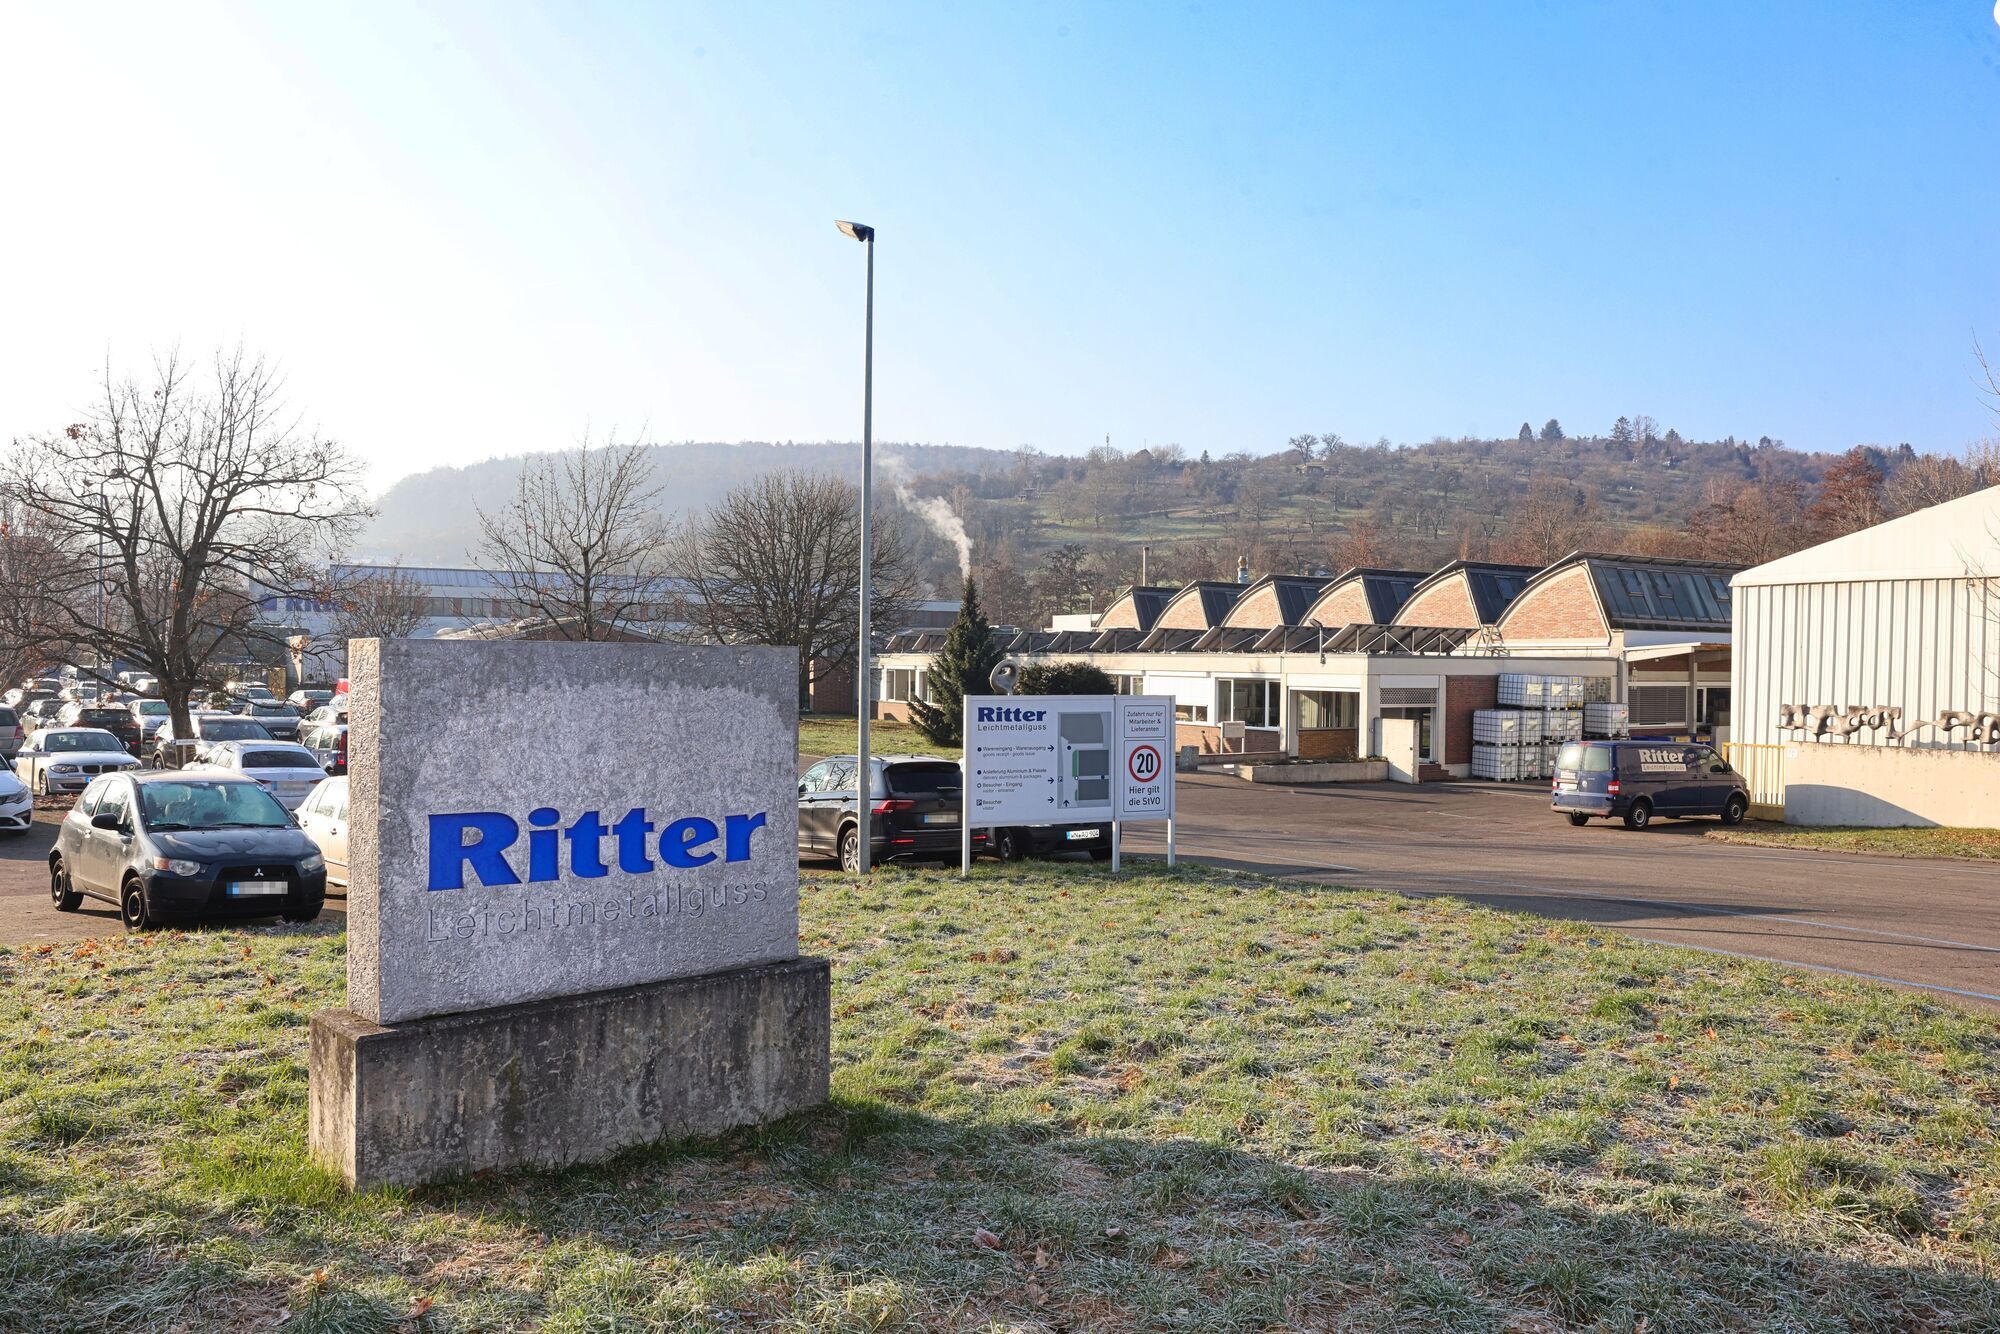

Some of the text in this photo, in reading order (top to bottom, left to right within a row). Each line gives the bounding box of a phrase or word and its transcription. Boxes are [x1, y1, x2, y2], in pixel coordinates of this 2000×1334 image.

[978, 707, 1046, 722] Ritter
[978, 724, 1047, 732] Leichtmetallguss
[1639, 749, 1684, 762] Ritter
[1137, 753, 1153, 773] 20
[1129, 785, 1160, 795] Hier gilt
[1129, 797, 1160, 806] die StVO
[428, 807, 766, 891] Ritter
[427, 880, 768, 943] Leichtmetallguss
